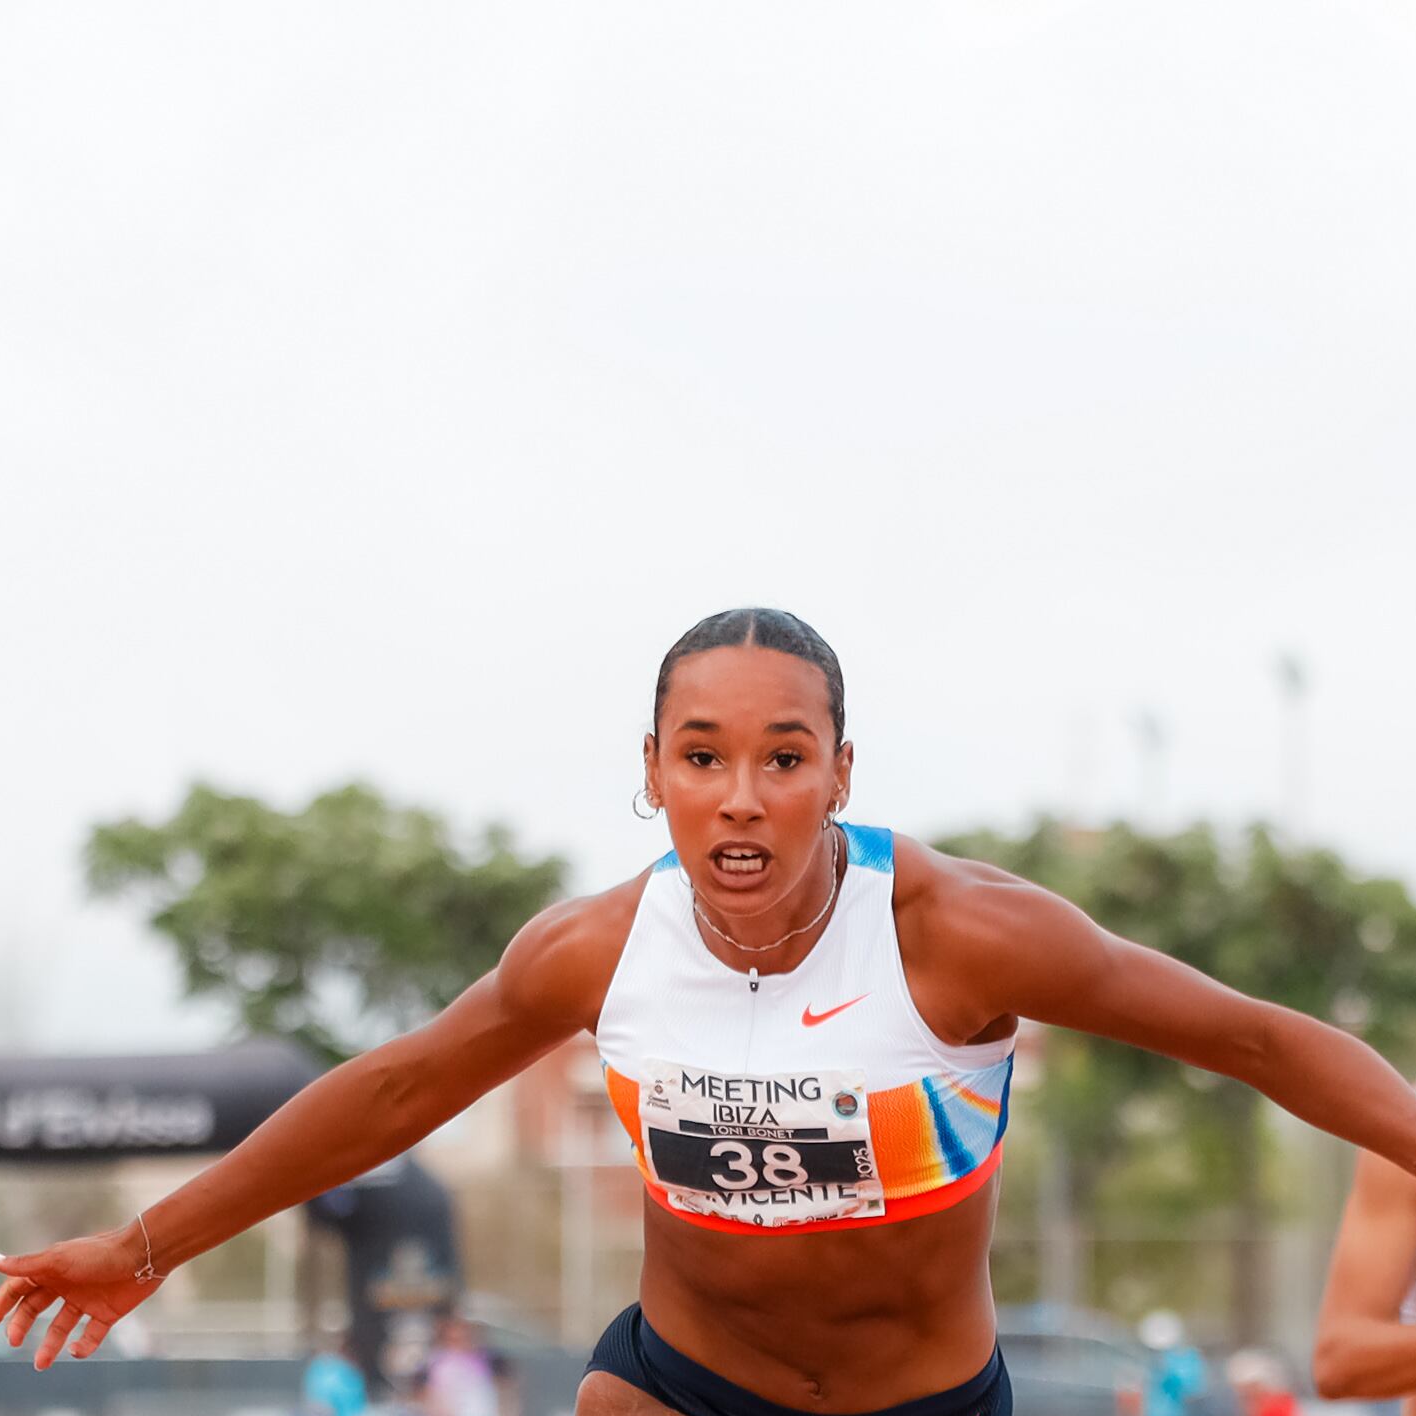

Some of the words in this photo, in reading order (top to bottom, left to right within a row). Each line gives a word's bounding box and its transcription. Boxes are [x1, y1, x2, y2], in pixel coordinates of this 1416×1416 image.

[682, 1070, 821, 1104] MEETING
[712, 1102, 780, 1127] IBIZA
[709, 1125, 743, 1137] TONI
[746, 1127, 795, 1140] BONET
[710, 1141, 809, 1190] 38
